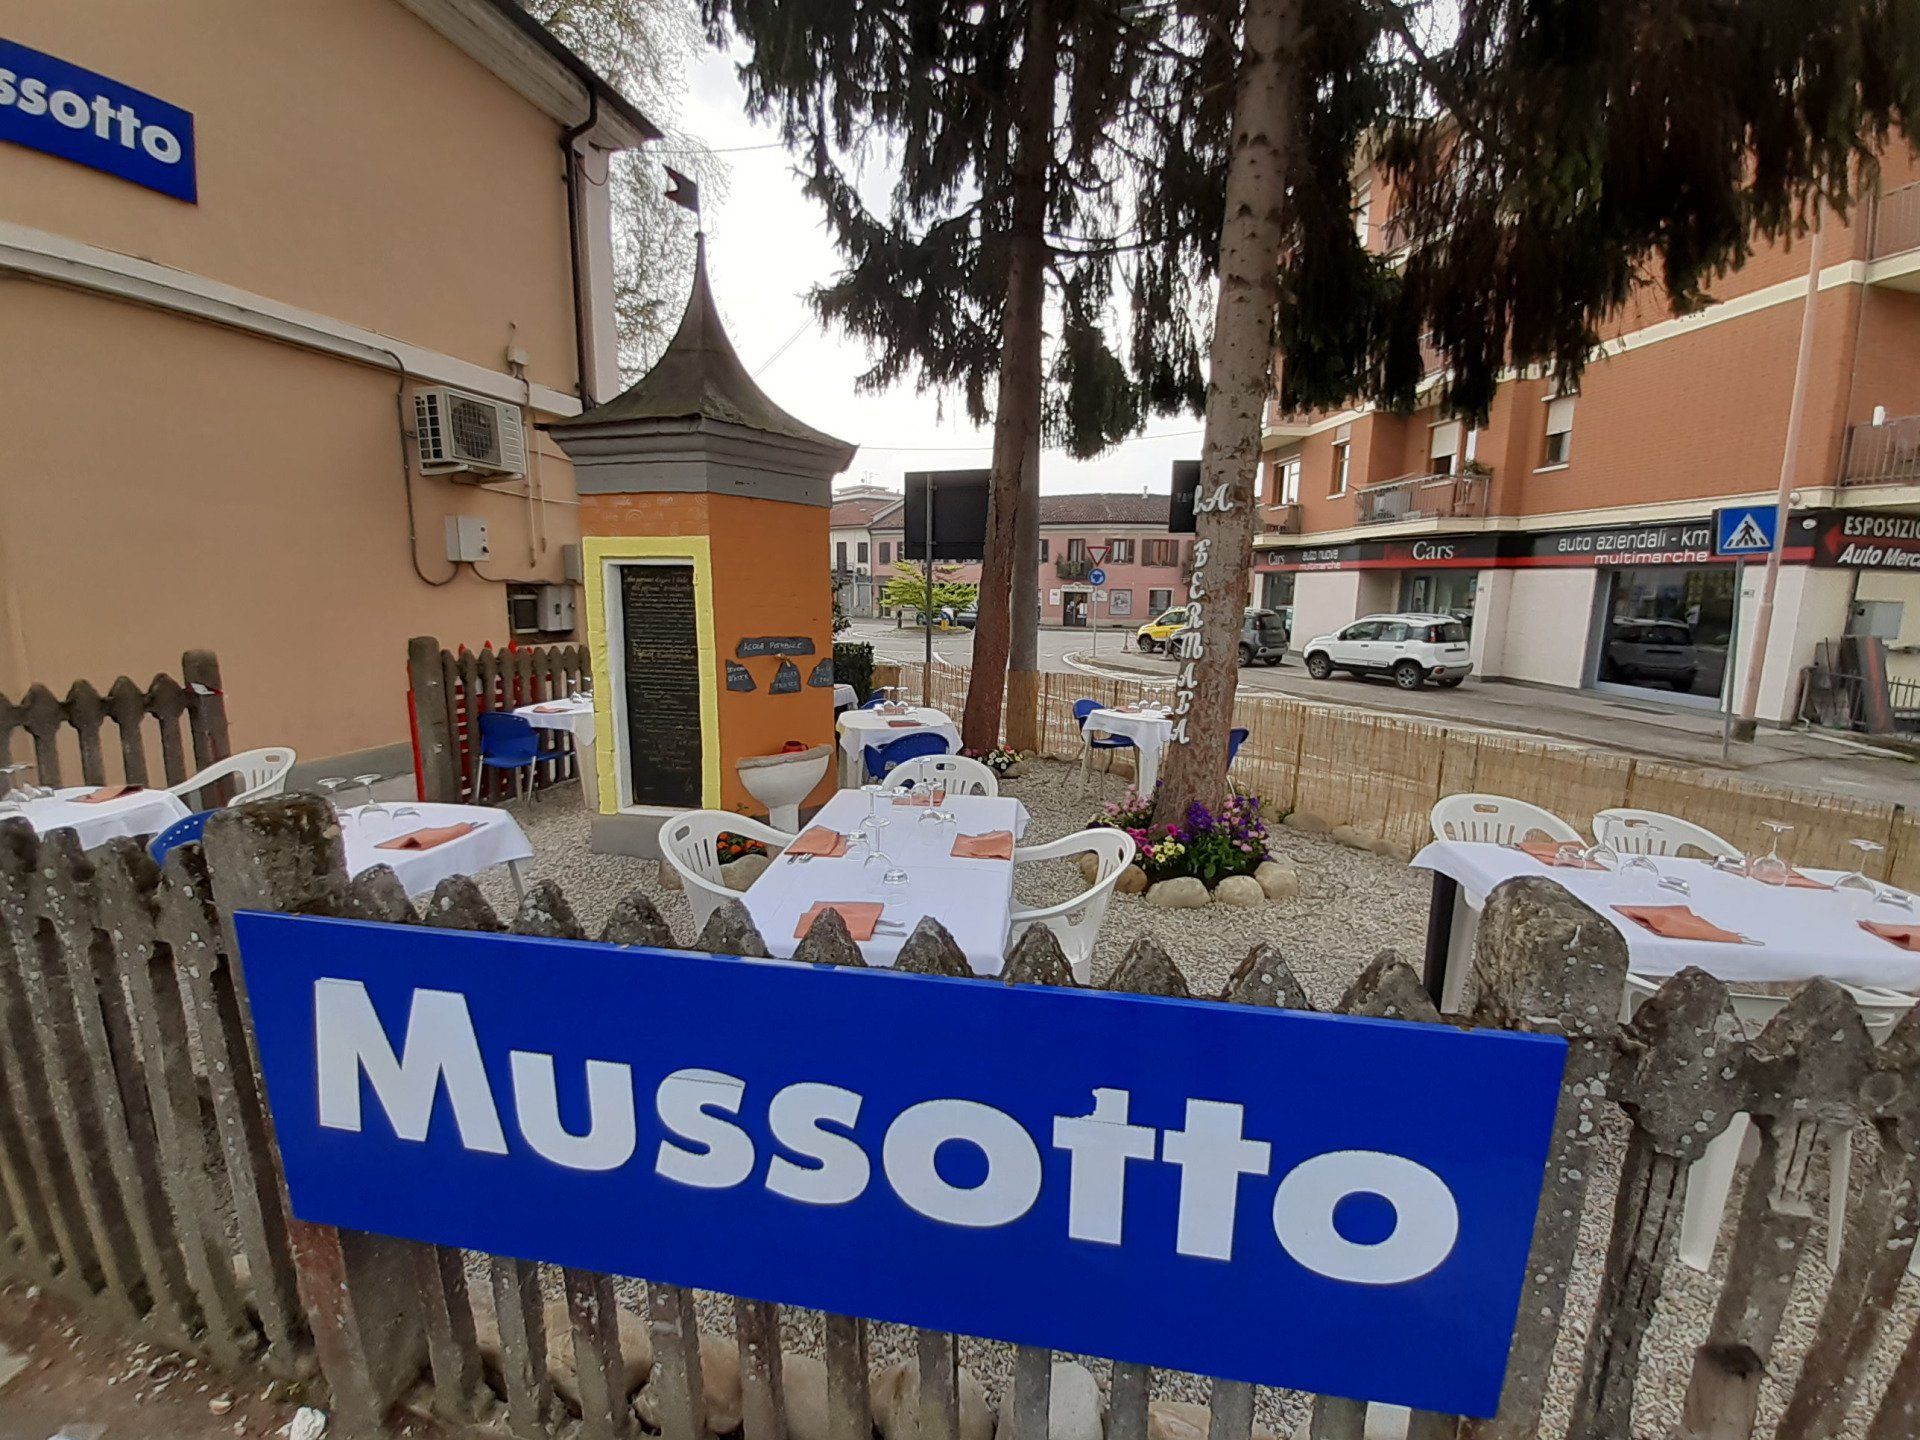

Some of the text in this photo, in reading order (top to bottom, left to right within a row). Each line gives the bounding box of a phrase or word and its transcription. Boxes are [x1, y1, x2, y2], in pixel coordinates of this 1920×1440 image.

[1193, 483, 1234, 515] LA
[1558, 535, 1591, 552] auto
[1596, 528, 1666, 551] aziendali
[1681, 526, 1710, 547] km
[1268, 551, 1285, 566] Cars
[1412, 541, 1455, 560] Cars
[1594, 549, 1709, 565] multimarche
[1837, 543, 1883, 565] Auto
[314, 977, 1461, 1287] Mussotto
